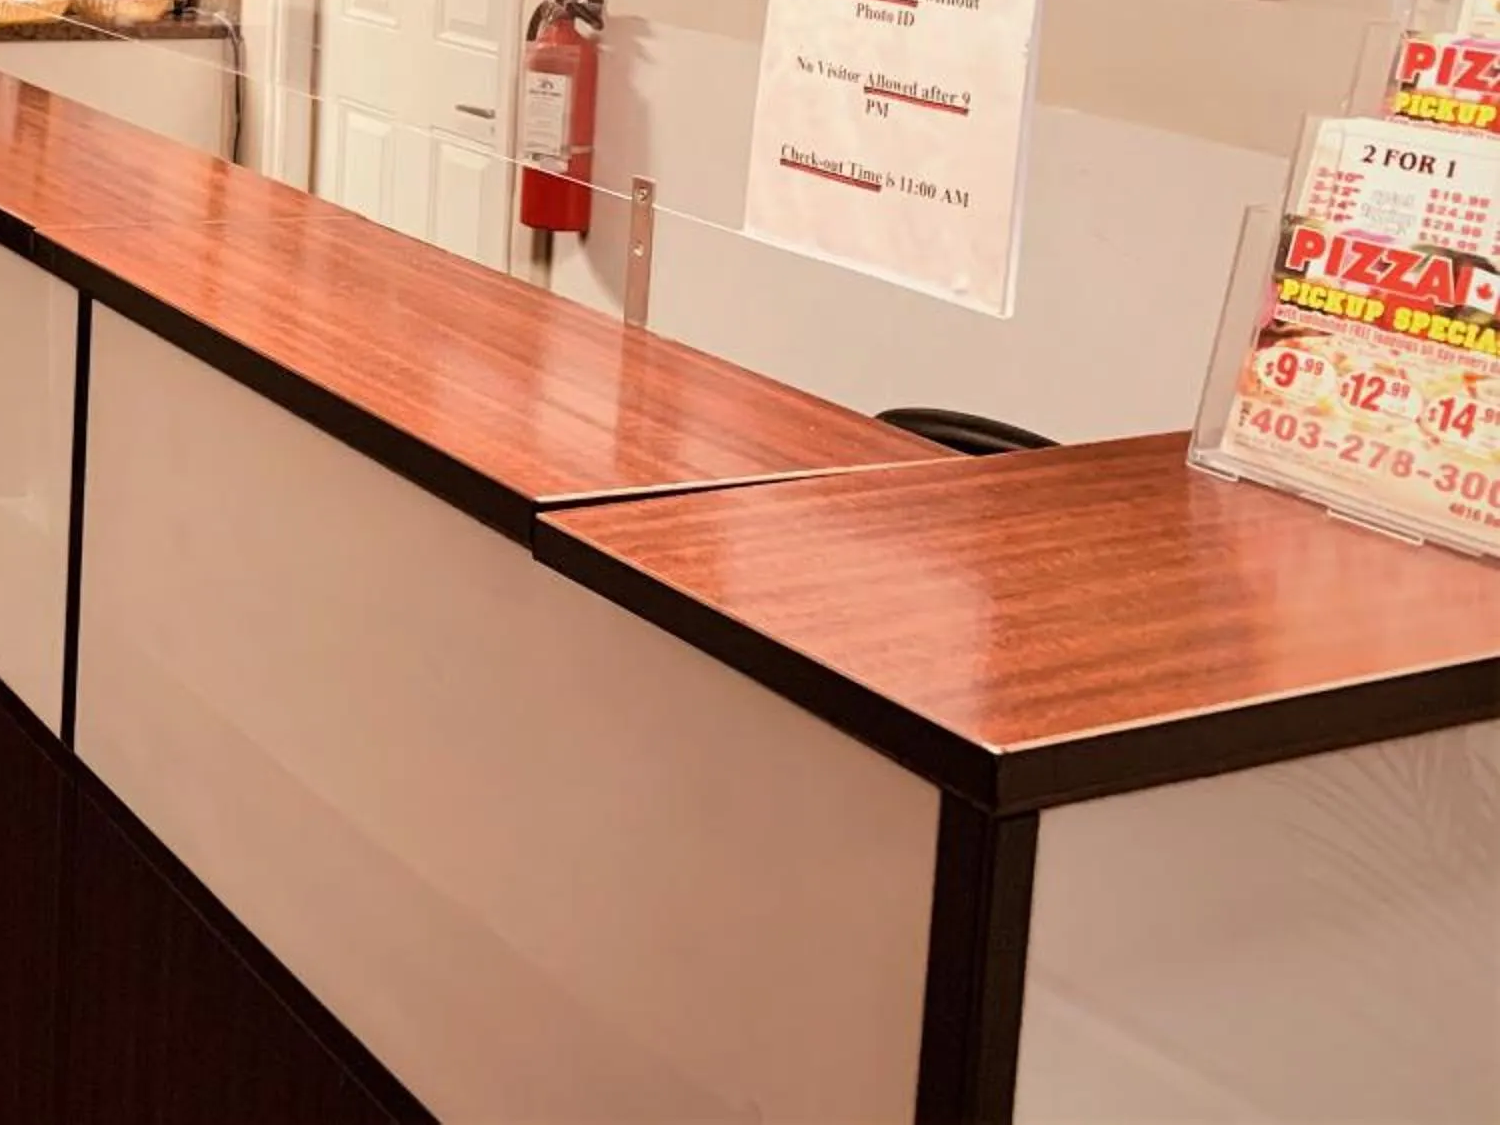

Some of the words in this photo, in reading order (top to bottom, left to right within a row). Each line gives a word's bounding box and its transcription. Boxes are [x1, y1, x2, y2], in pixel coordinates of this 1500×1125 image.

[856, 3, 894, 23] Photo
[897, 10, 915, 27] ID
[797, 55, 814, 73] No
[817, 60, 861, 83] Visitor
[866, 72, 918, 96] Allowed
[922, 85, 958, 105] after
[961, 91, 971, 105] 9
[1399, 40, 1500, 93] PIZ
[866, 98, 889, 118] PM
[1395, 91, 1497, 128] PICKUP
[781, 143, 844, 173] Check-out
[847, 160, 883, 183] Time
[886, 171, 895, 186] is
[900, 176, 937, 199] 11:00
[939, 189, 969, 208] AM
[1362, 145, 1377, 163] 2
[1383, 148, 1436, 175] FOR
[1446, 160, 1457, 178] 1
[1286, 225, 1455, 306] PIZZA
[1281, 278, 1385, 322] PICKUP
[1392, 306, 1500, 357] SPECIA
[1265, 352, 1325, 388] $9.99
[1340, 373, 1411, 412] $12.99
